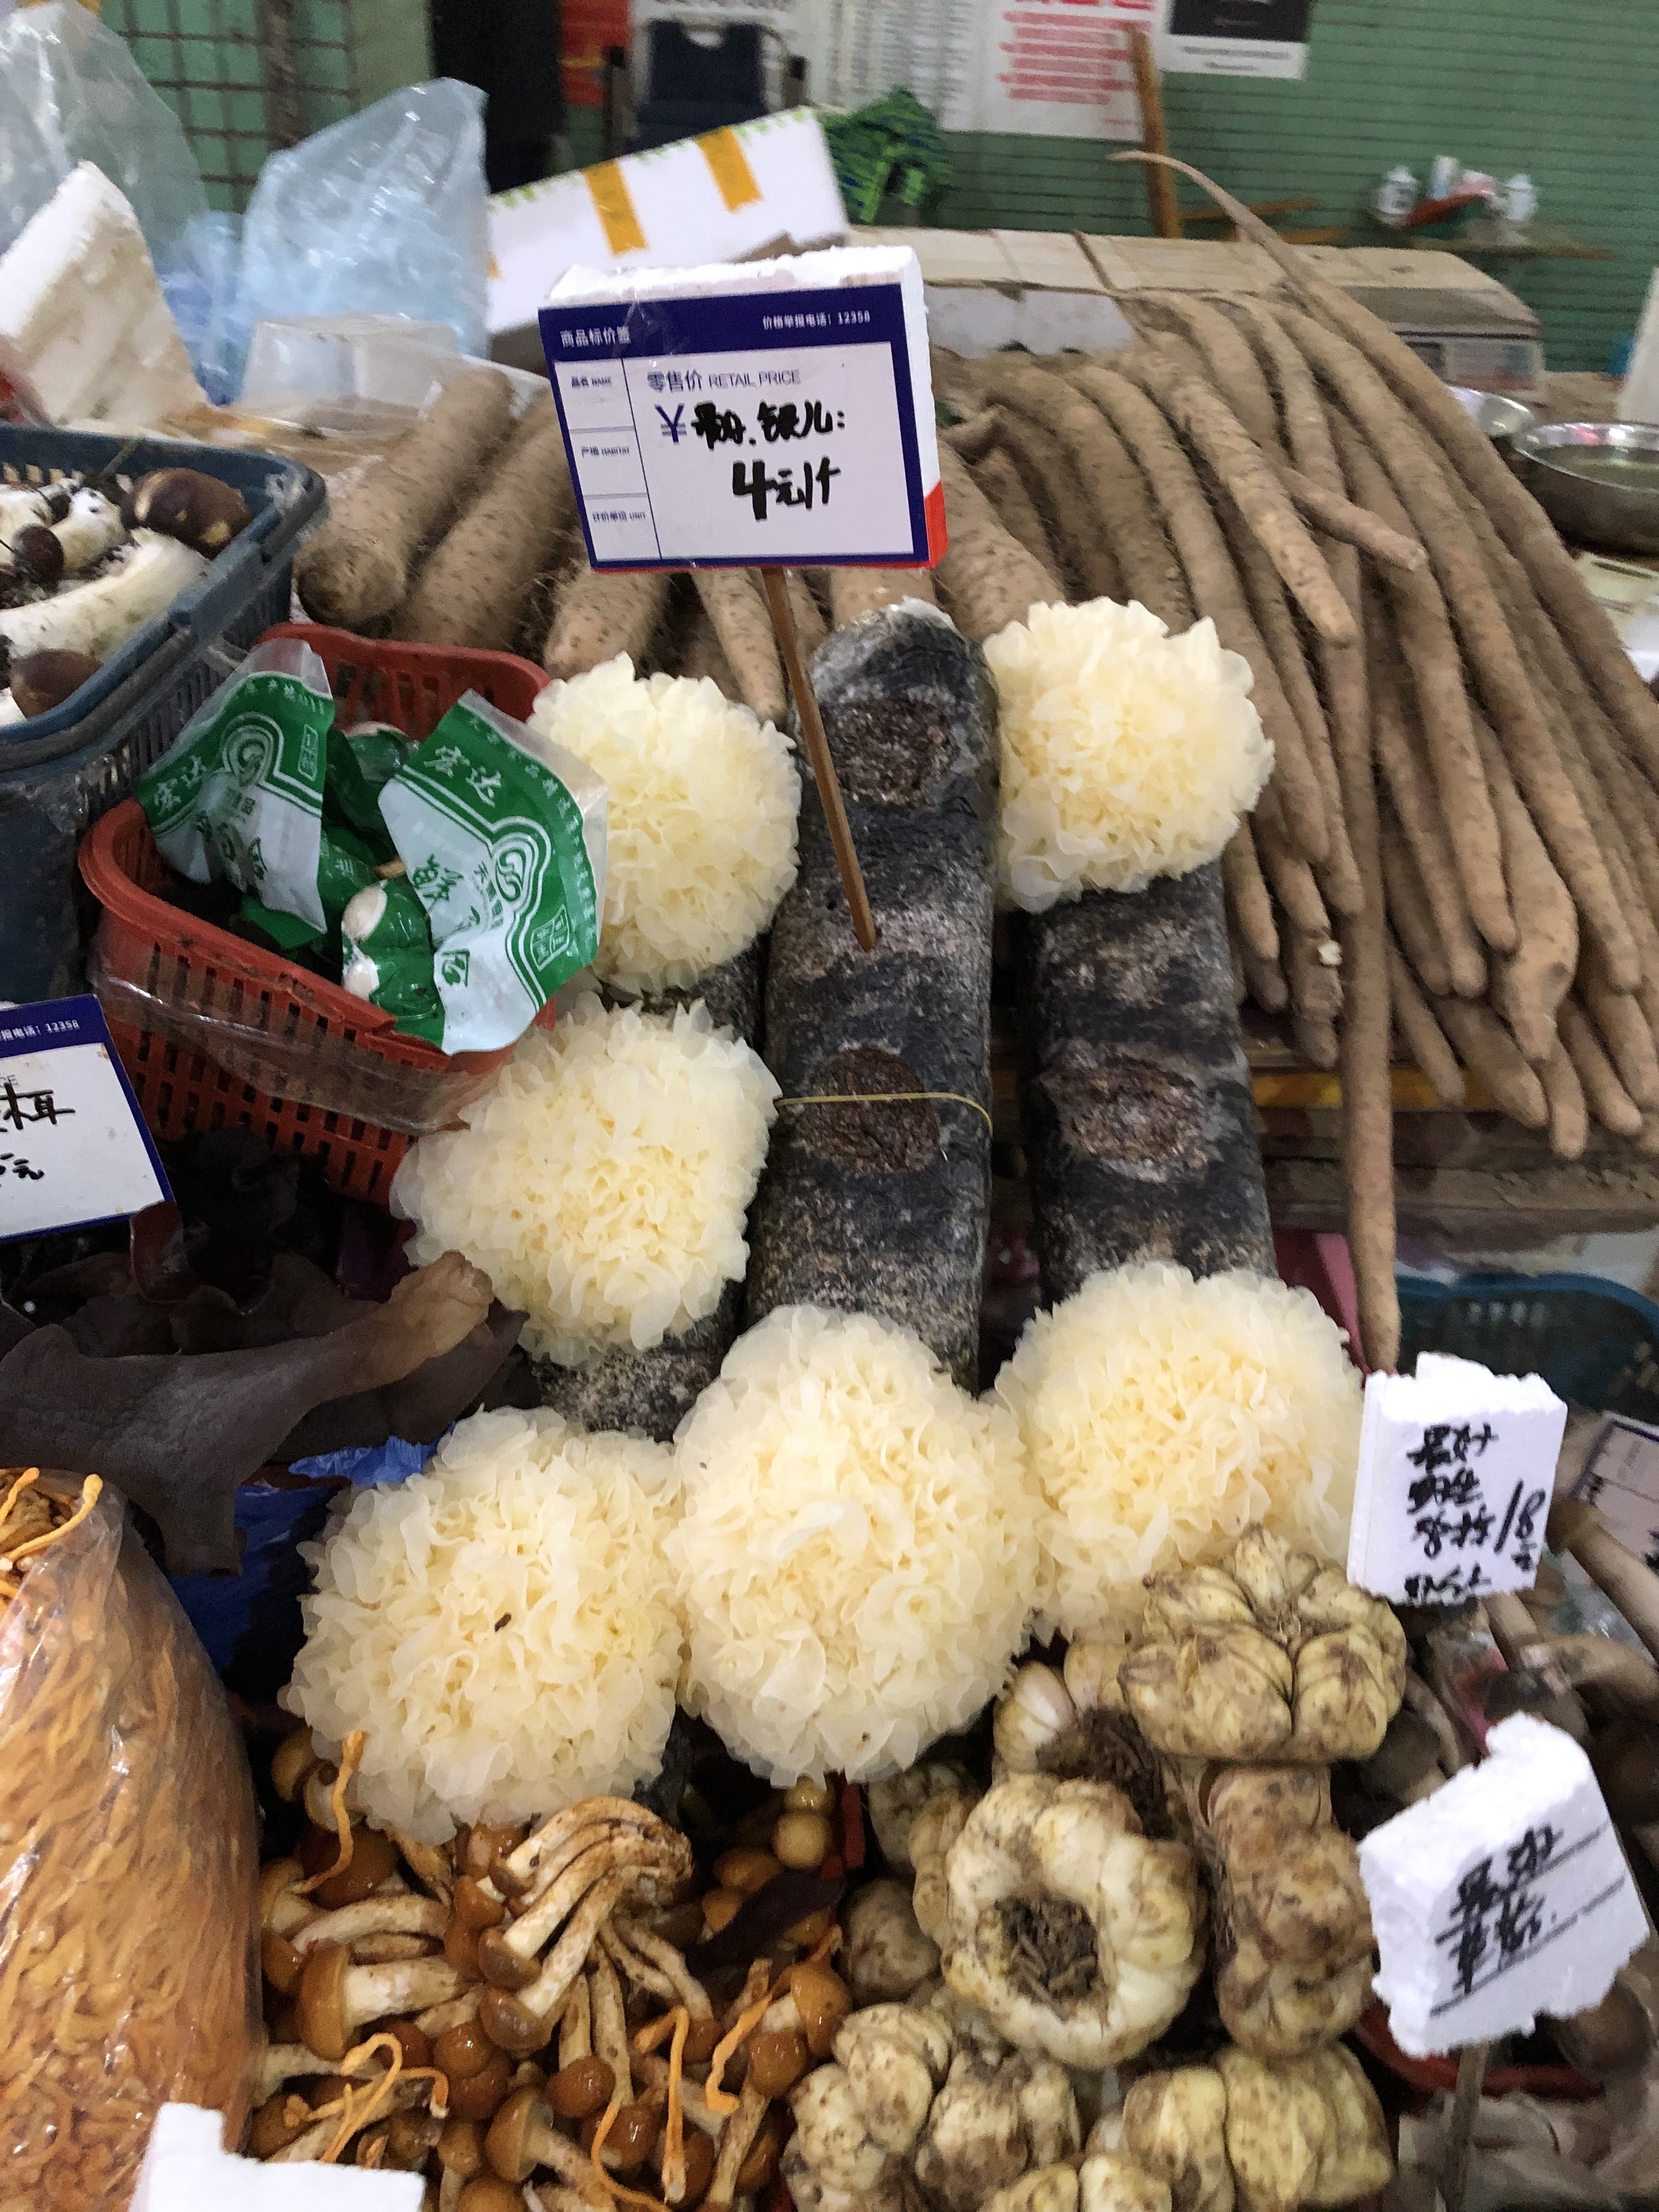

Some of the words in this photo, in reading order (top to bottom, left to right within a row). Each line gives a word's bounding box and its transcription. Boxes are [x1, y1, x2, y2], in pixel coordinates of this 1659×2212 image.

[647, 369, 702, 393] 零售价
[708, 372, 758, 389] RETAIL
[758, 369, 801, 385] PRICE
